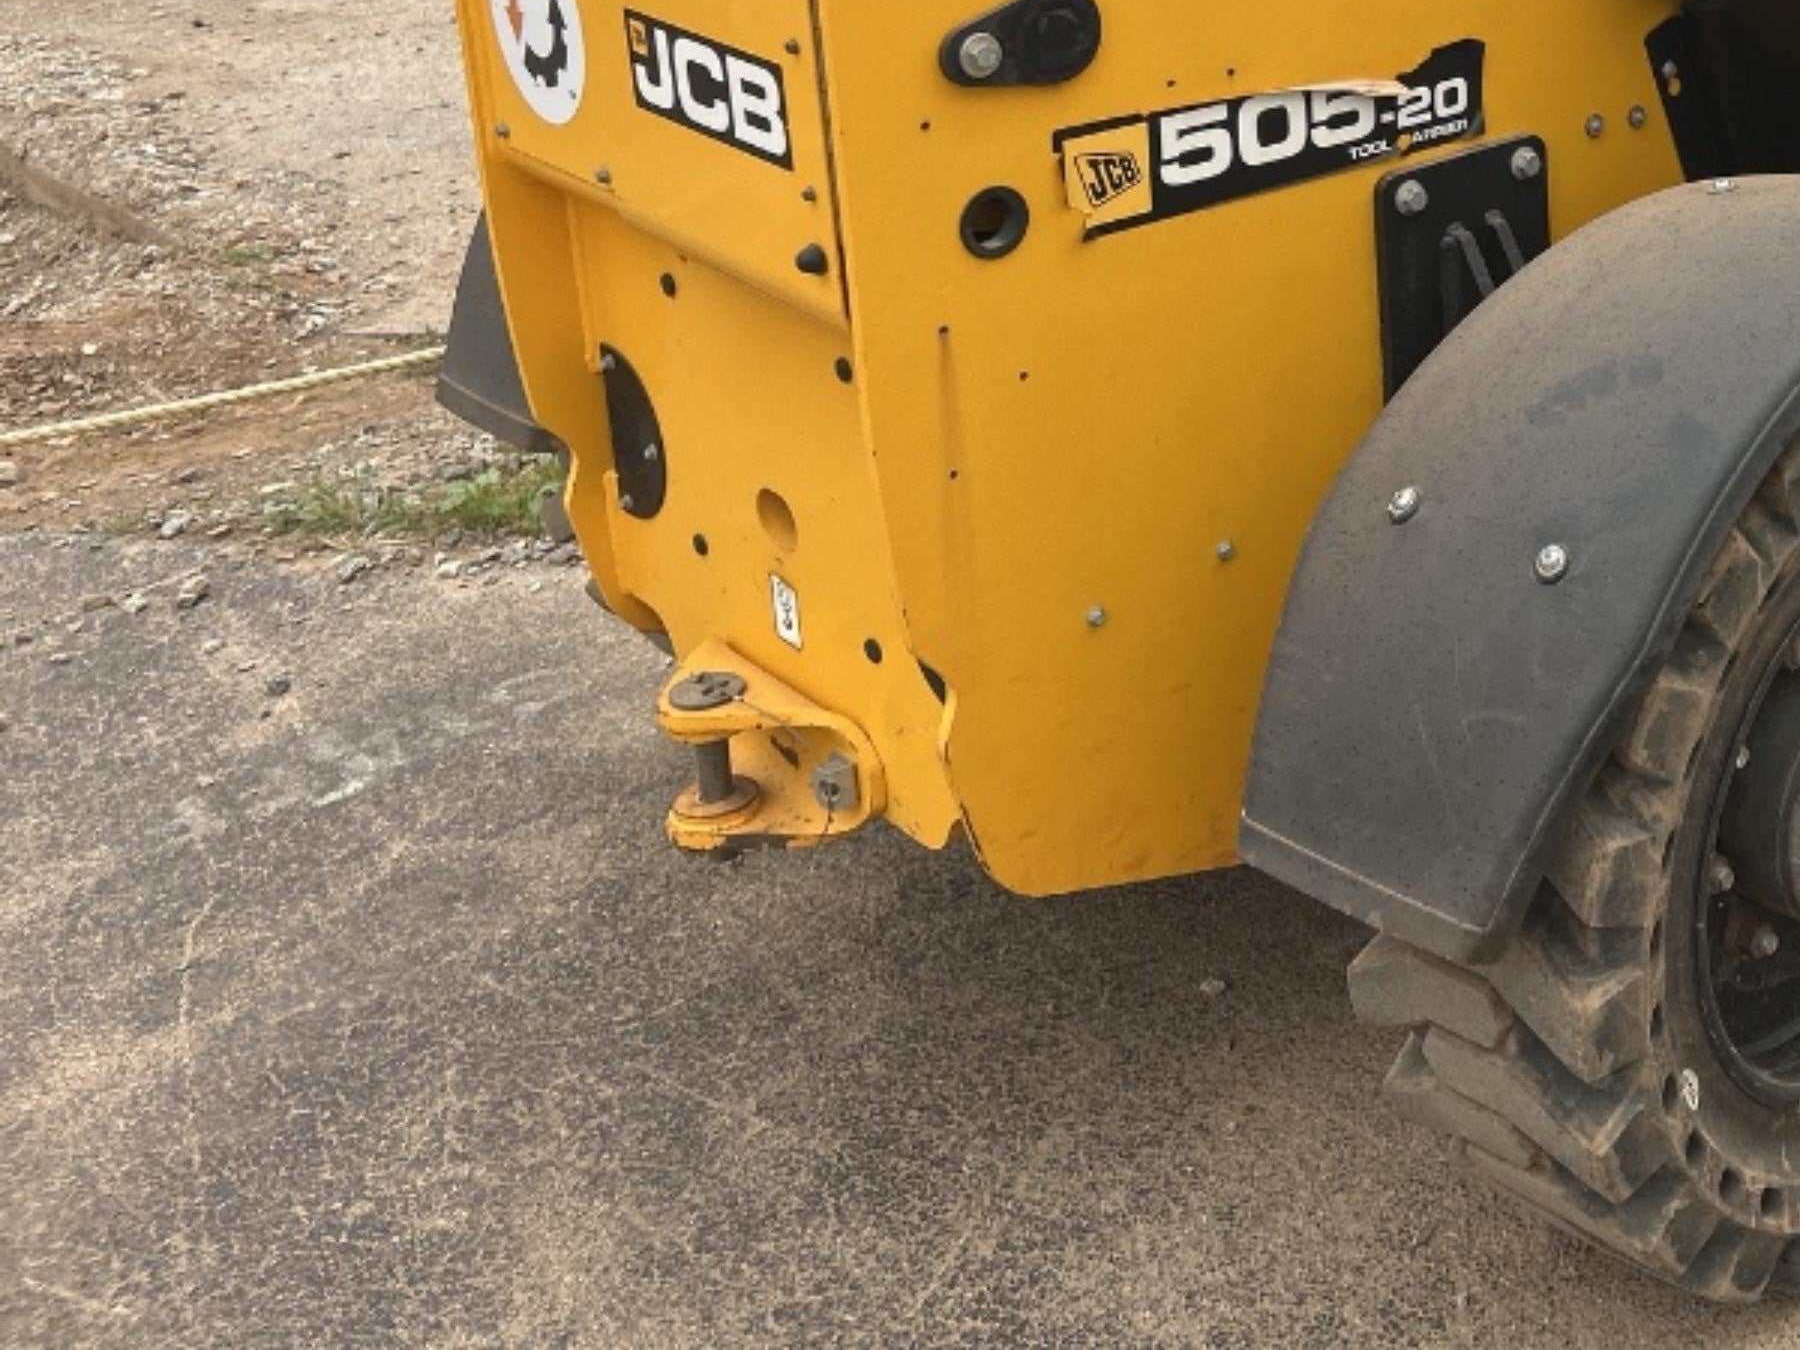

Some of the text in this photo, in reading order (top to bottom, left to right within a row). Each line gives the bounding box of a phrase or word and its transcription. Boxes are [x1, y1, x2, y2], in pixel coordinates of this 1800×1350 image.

[636, 26, 788, 156] JCB
[1159, 76, 1467, 187] 505-20
[1087, 155, 1138, 201] JCB
